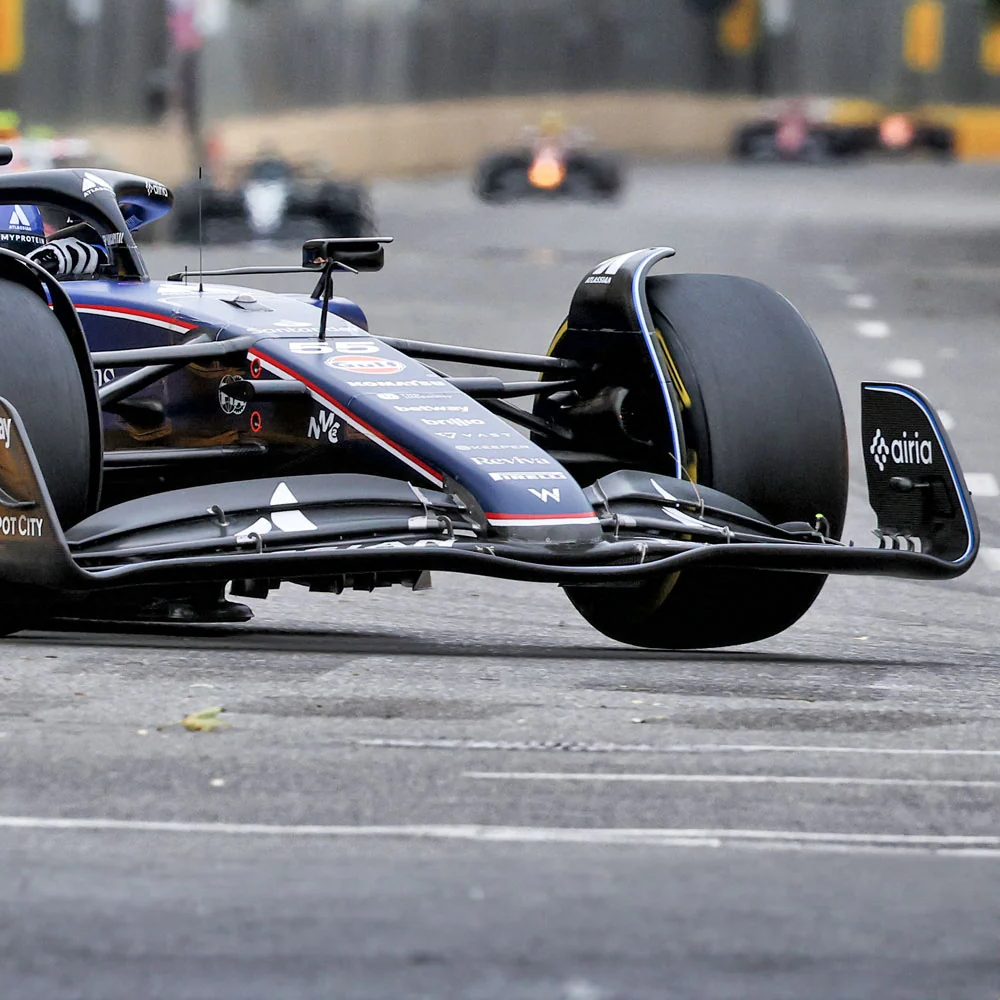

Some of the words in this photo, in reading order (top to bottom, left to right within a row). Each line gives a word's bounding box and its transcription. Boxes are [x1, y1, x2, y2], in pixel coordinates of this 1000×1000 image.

[288, 341, 380, 354] 55
[891, 431, 933, 465] airia
[470, 456, 550, 466] Reviva
[18, 514, 44, 537] CITY
